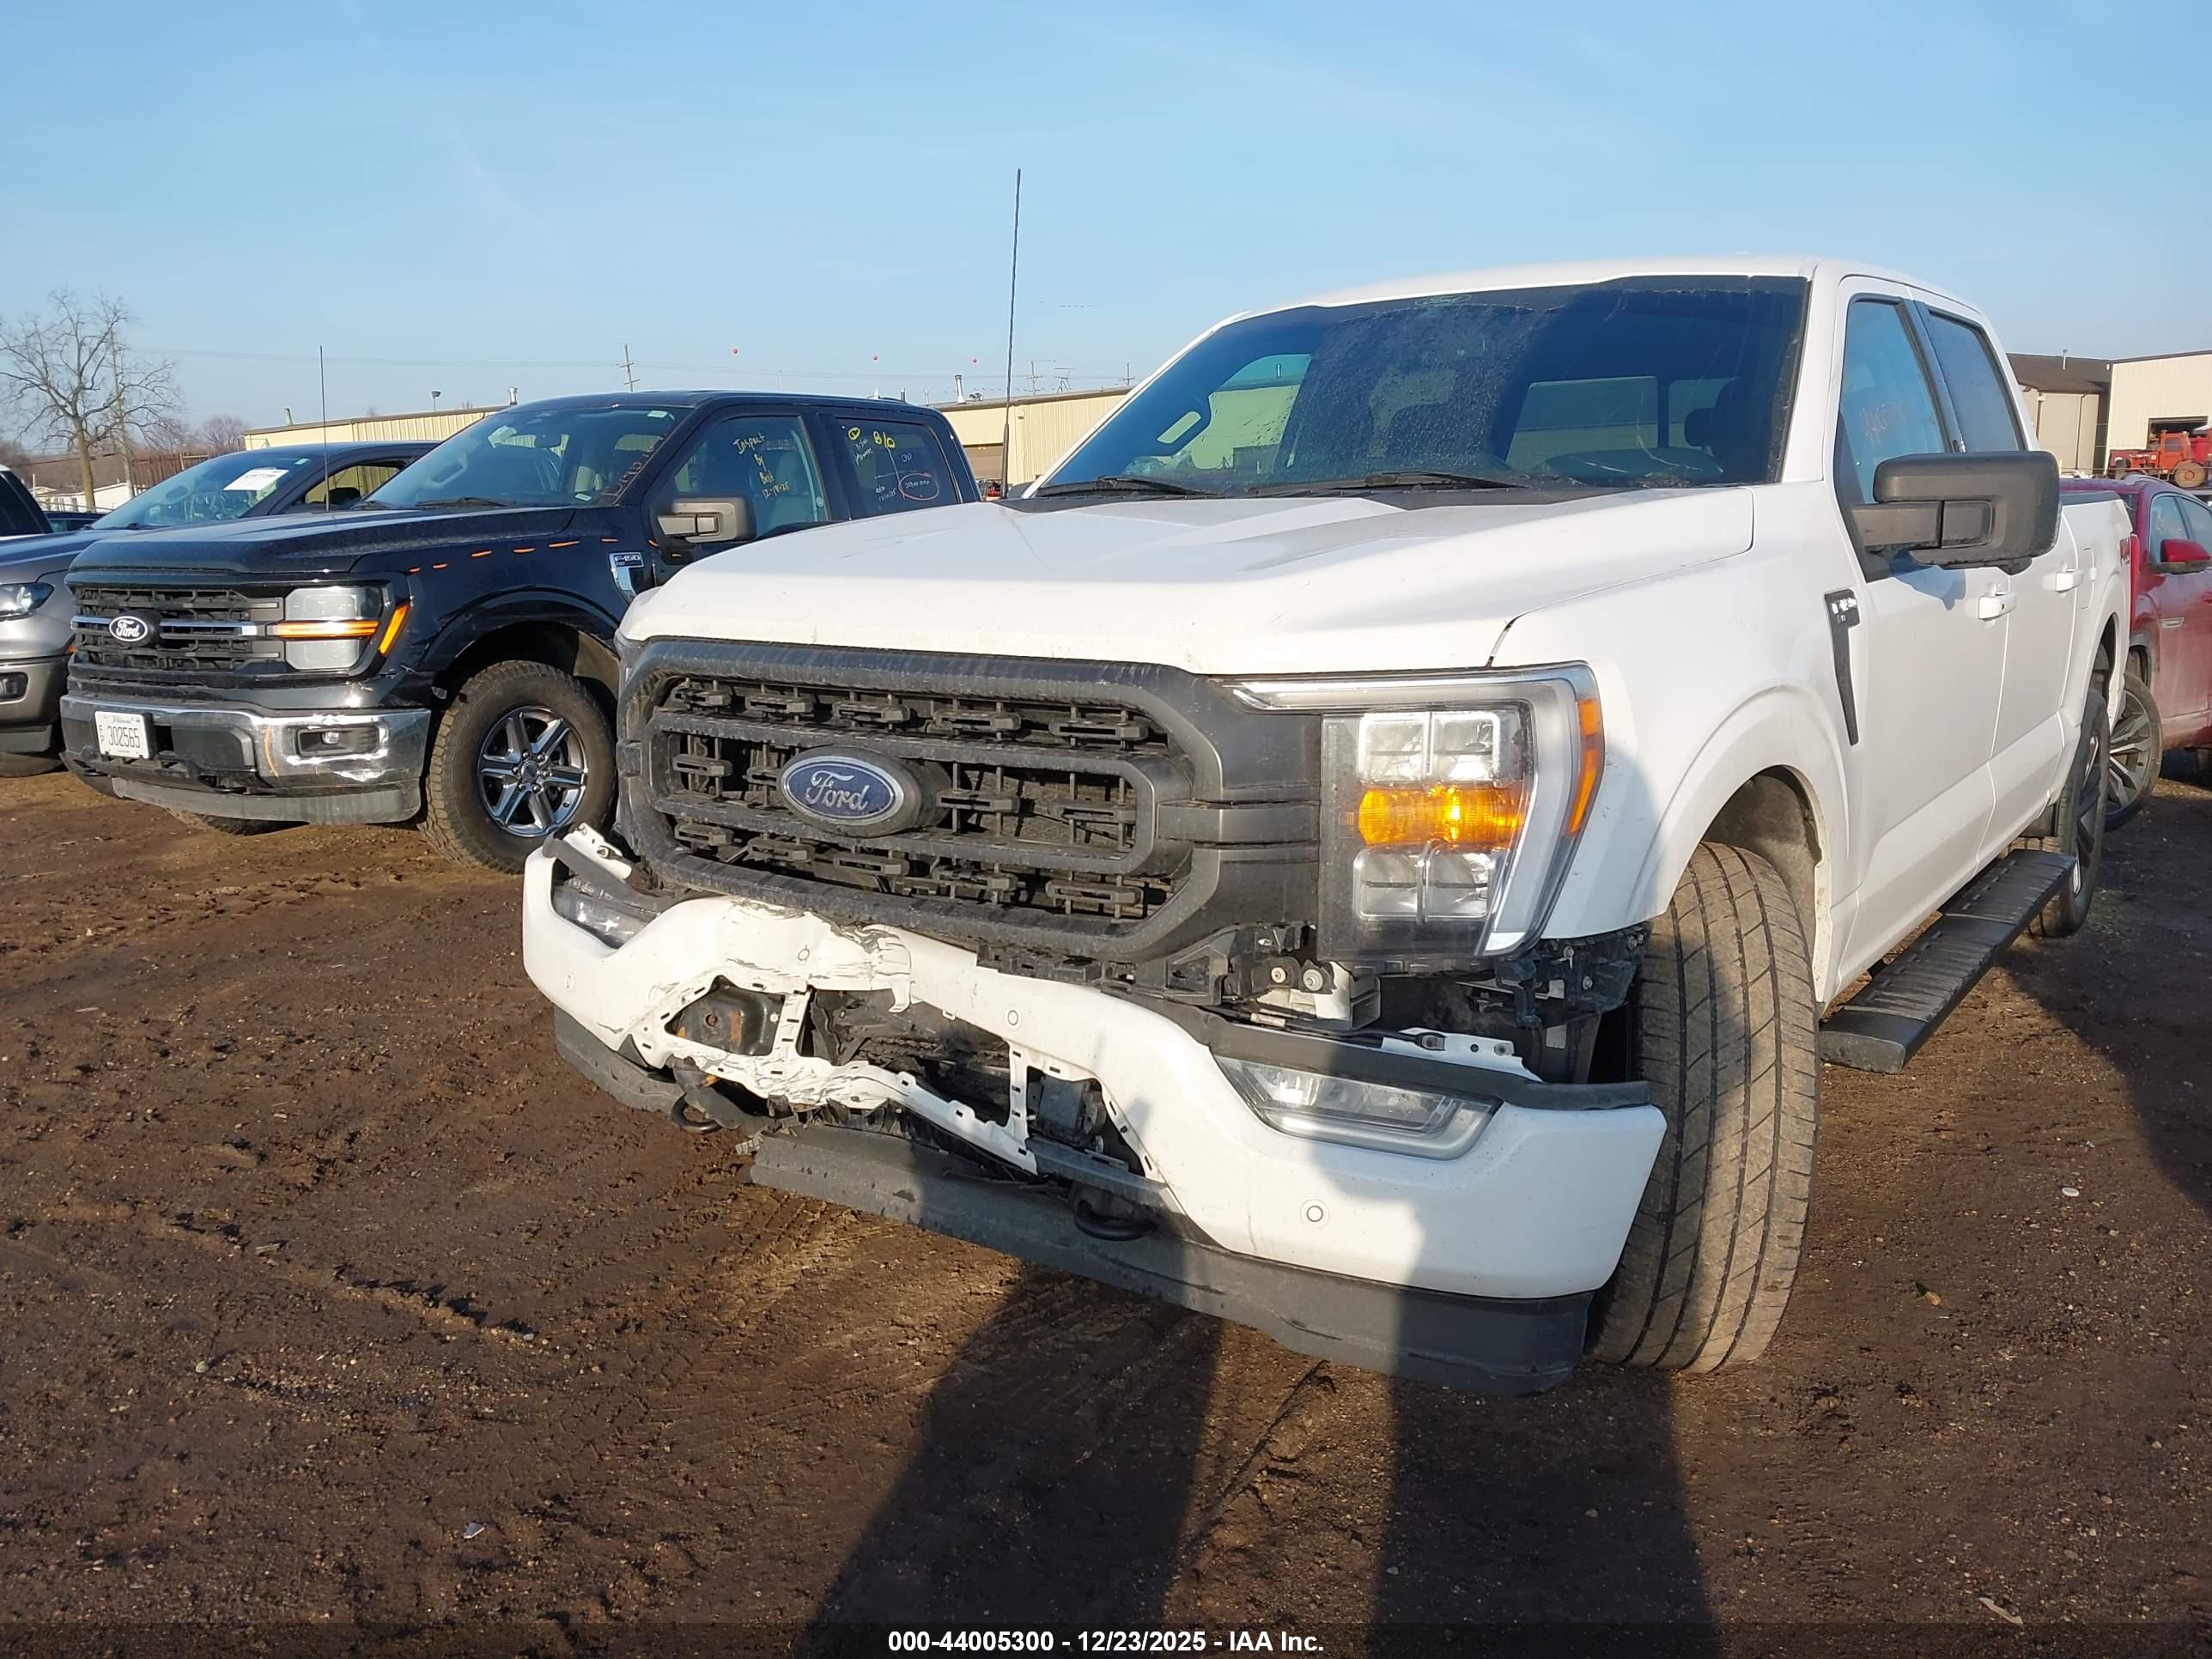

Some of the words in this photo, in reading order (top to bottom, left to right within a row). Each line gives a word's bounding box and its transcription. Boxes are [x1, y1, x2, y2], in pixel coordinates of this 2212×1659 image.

[116, 619, 140, 637] Ford
[107, 726, 141, 749] 302565
[805, 770, 870, 811] Ford
